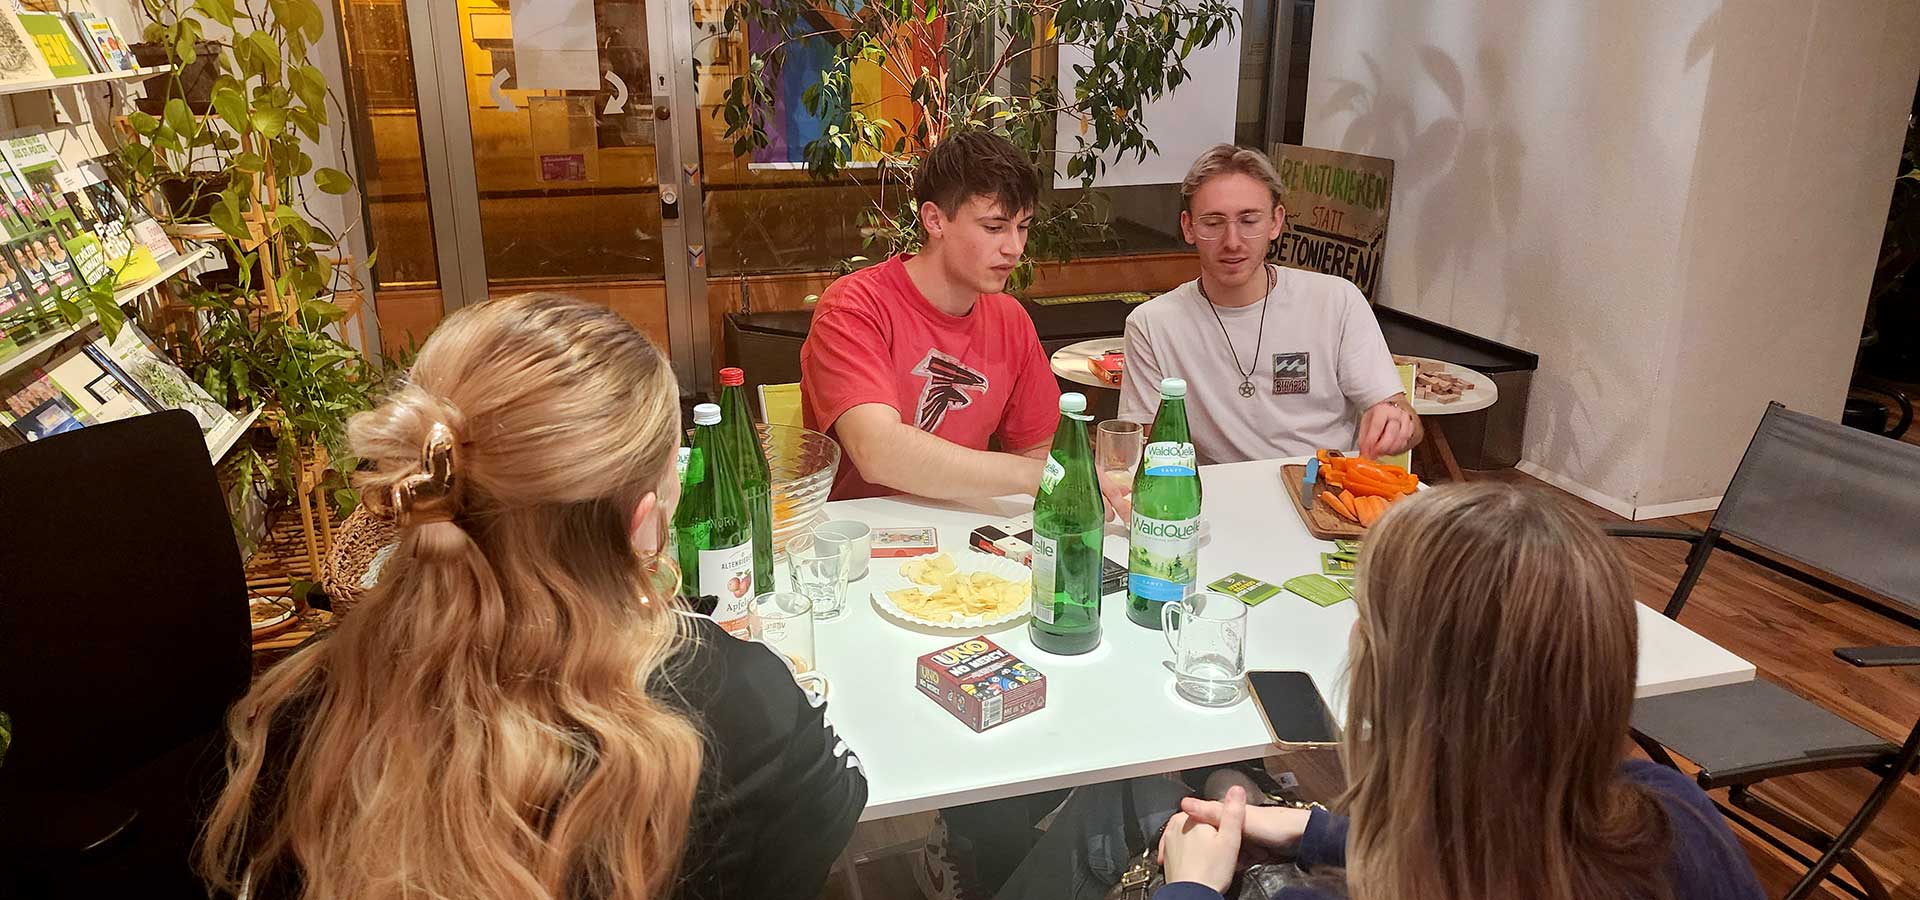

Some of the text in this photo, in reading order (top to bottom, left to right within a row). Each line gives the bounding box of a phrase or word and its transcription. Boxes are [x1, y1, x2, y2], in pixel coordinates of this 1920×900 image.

[1312, 206, 1344, 233] STATT
[1267, 232, 1380, 300] BETONIEREN!
[1133, 514, 1200, 539] WaldQuelle
[931, 640, 989, 666] UNO
[948, 665, 971, 677] NO
